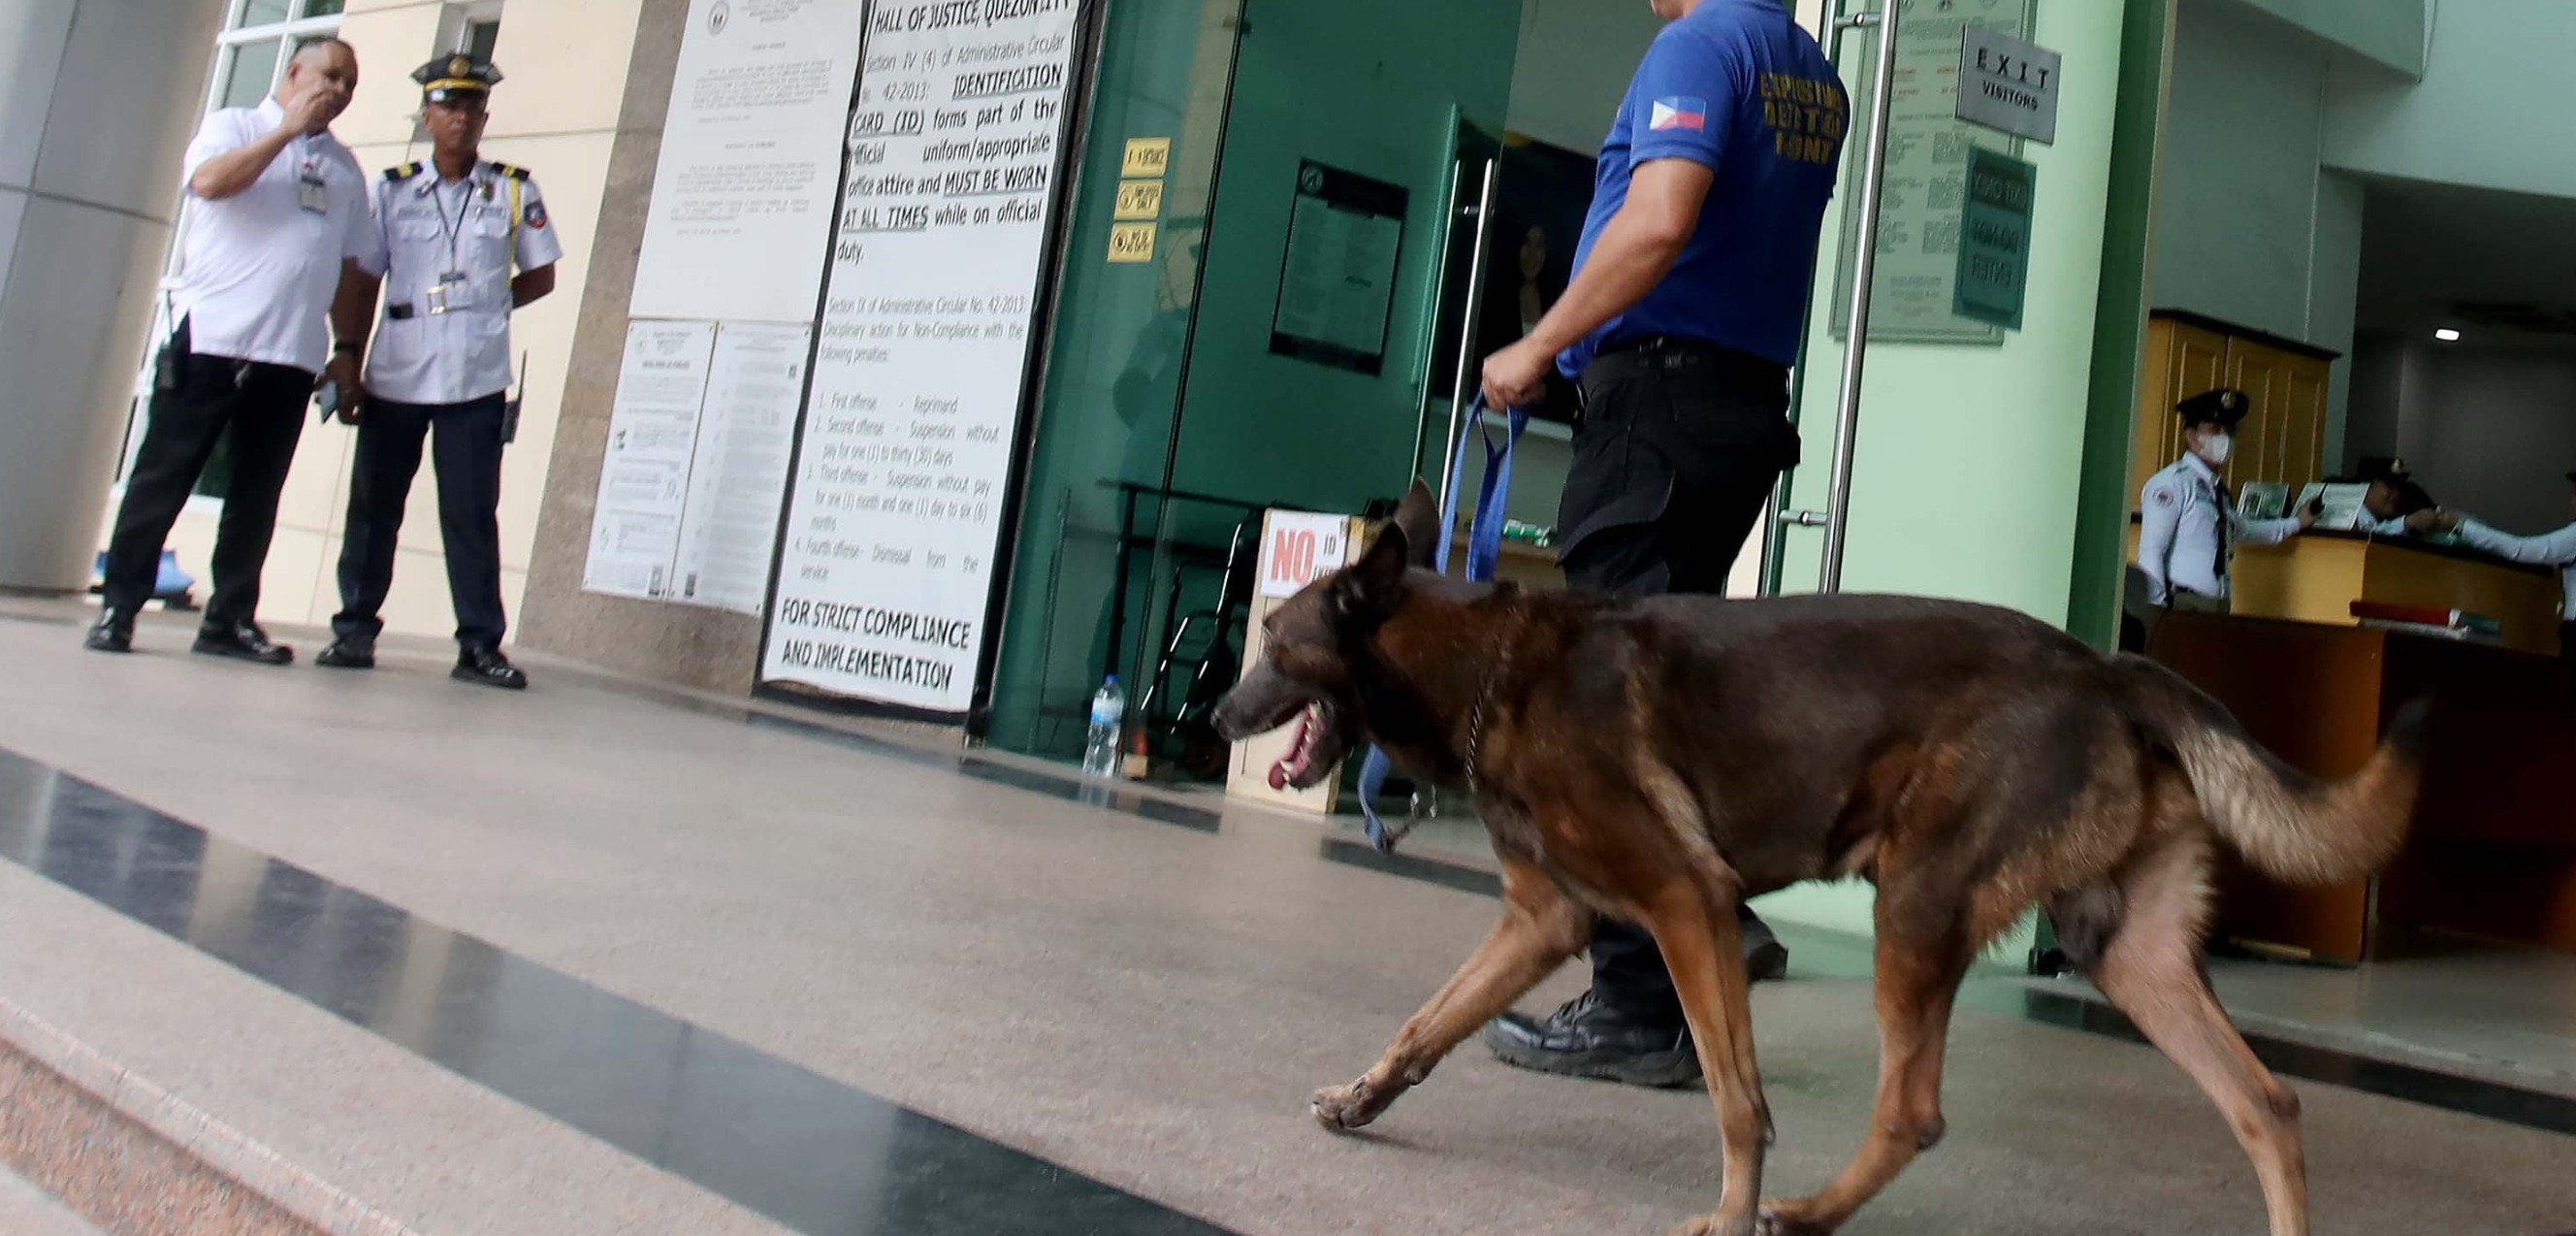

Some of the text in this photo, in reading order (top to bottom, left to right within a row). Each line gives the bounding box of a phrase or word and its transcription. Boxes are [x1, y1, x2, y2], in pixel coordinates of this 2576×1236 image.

[874, 7, 902, 34] HALL
[908, 5, 927, 31] OF
[928, 0, 981, 30] JUSTICE,
[985, 0, 1038, 27] QUEZON
[903, 50, 918, 71] IV
[920, 48, 937, 74] (4)
[942, 49, 952, 67] of
[956, 42, 1025, 66] Administrative
[1028, 32, 1066, 54] Circular
[1978, 46, 2049, 88] EXIT
[883, 81, 931, 102] 42-2013:
[952, 62, 1063, 99] IDENTIFICATION
[1982, 80, 2038, 112] VISITORS
[853, 96, 1058, 136] CARD (ID) forms part of the
[923, 134, 1050, 163] uniform/appropriate
[876, 173, 914, 197] attire
[918, 171, 942, 194] and
[944, 171, 980, 195] MUST
[983, 168, 1000, 192] BE
[1005, 165, 1047, 190] WORN
[842, 198, 1042, 230] AT ALL TIMES while on official
[838, 240, 864, 265] duty.
[878, 297, 933, 315] Administrative
[936, 296, 967, 314] Circular
[824, 320, 1024, 342] Disciplinary action for Non-Compliance with the
[831, 391, 849, 410] First
[849, 393, 878, 412] offense
[913, 395, 959, 416] Reprimand
[828, 415, 854, 435] Second
[854, 418, 885, 436] offense
[909, 419, 955, 440] Suspension
[966, 424, 999, 442] without
[933, 448, 953, 470] days
[886, 470, 932, 489] Suspension
[937, 473, 970, 492] without
[973, 480, 992, 499] pay
[930, 499, 946, 520] day
[872, 544, 912, 566] Dismissal
[926, 550, 947, 569] from
[963, 555, 979, 573] the
[1272, 528, 1337, 584] NO ID
[800, 565, 829, 581] service
[781, 598, 972, 650] FOR STRICT COMPLIANCE
[782, 638, 953, 693] AND IMPLEMENTATION
